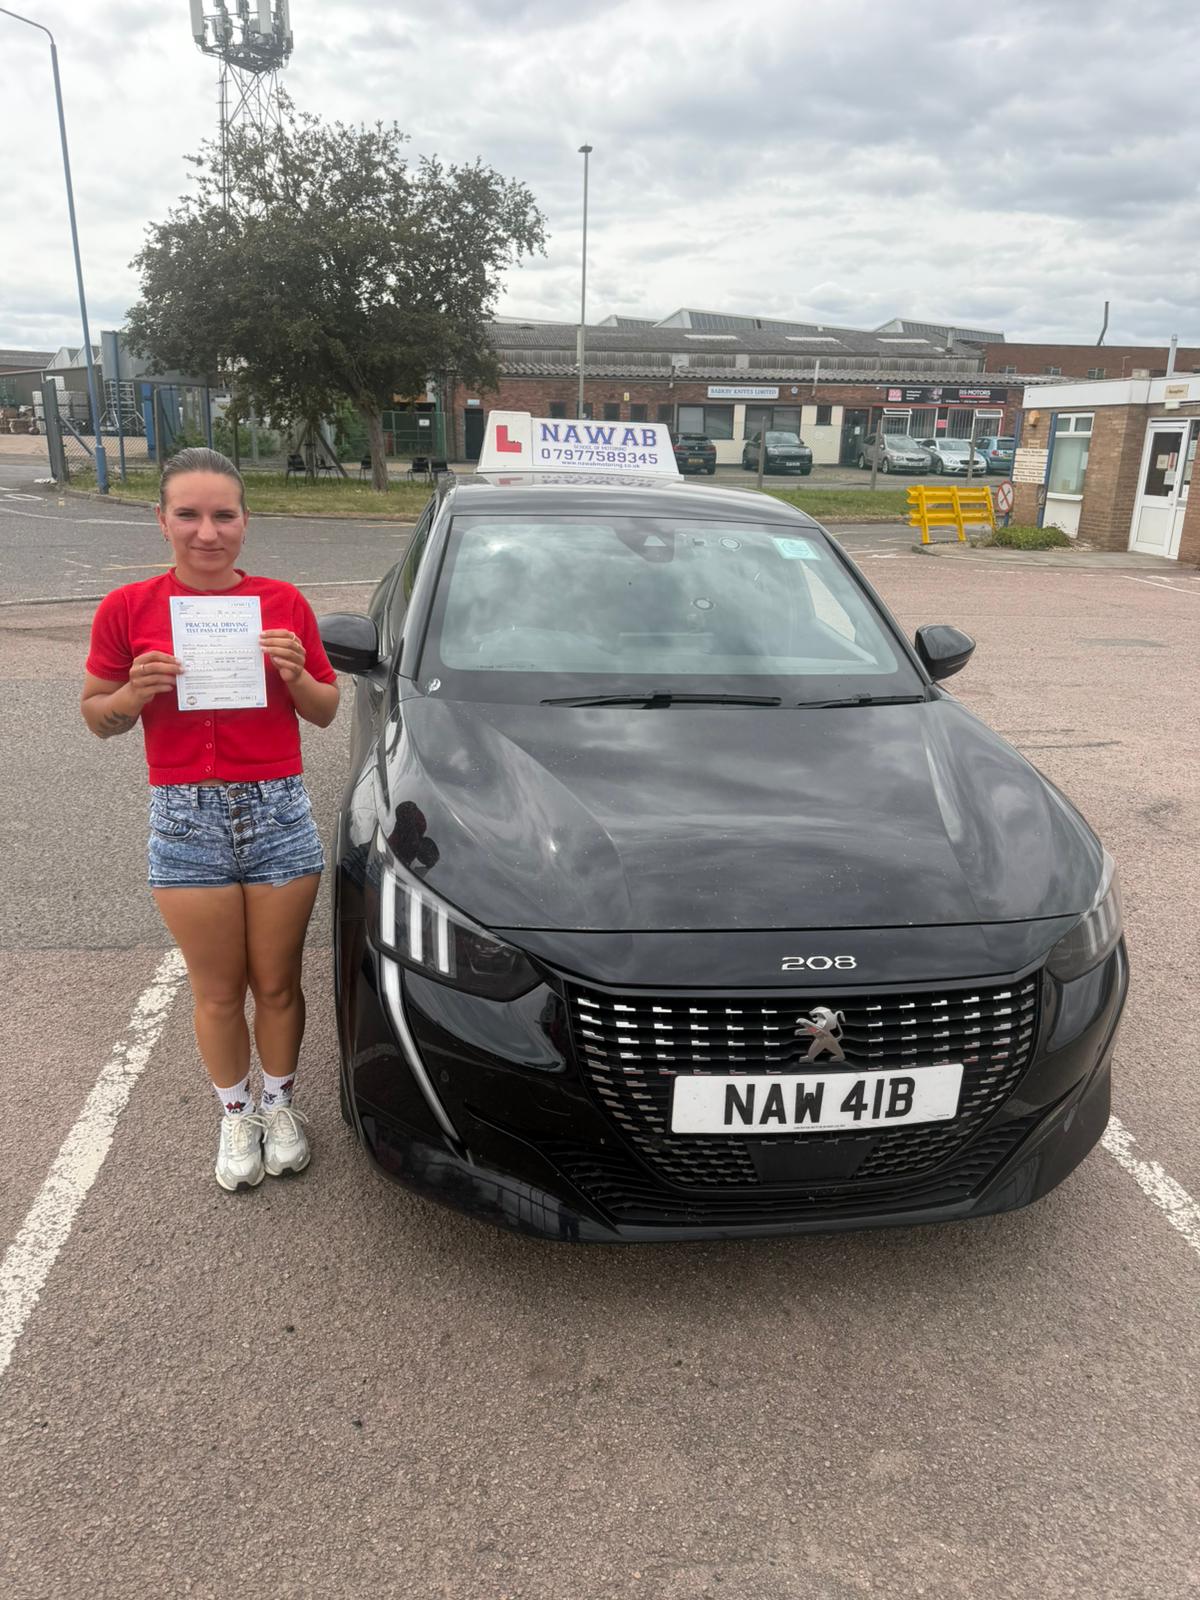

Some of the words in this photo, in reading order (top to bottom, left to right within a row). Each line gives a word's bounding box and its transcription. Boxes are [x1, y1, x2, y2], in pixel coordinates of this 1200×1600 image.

[496, 425, 522, 453] L
[540, 423, 657, 447] NAWAB
[541, 448, 658, 465] 07977589345
[781, 955, 858, 971] 208
[723, 1081, 825, 1126] NAW
